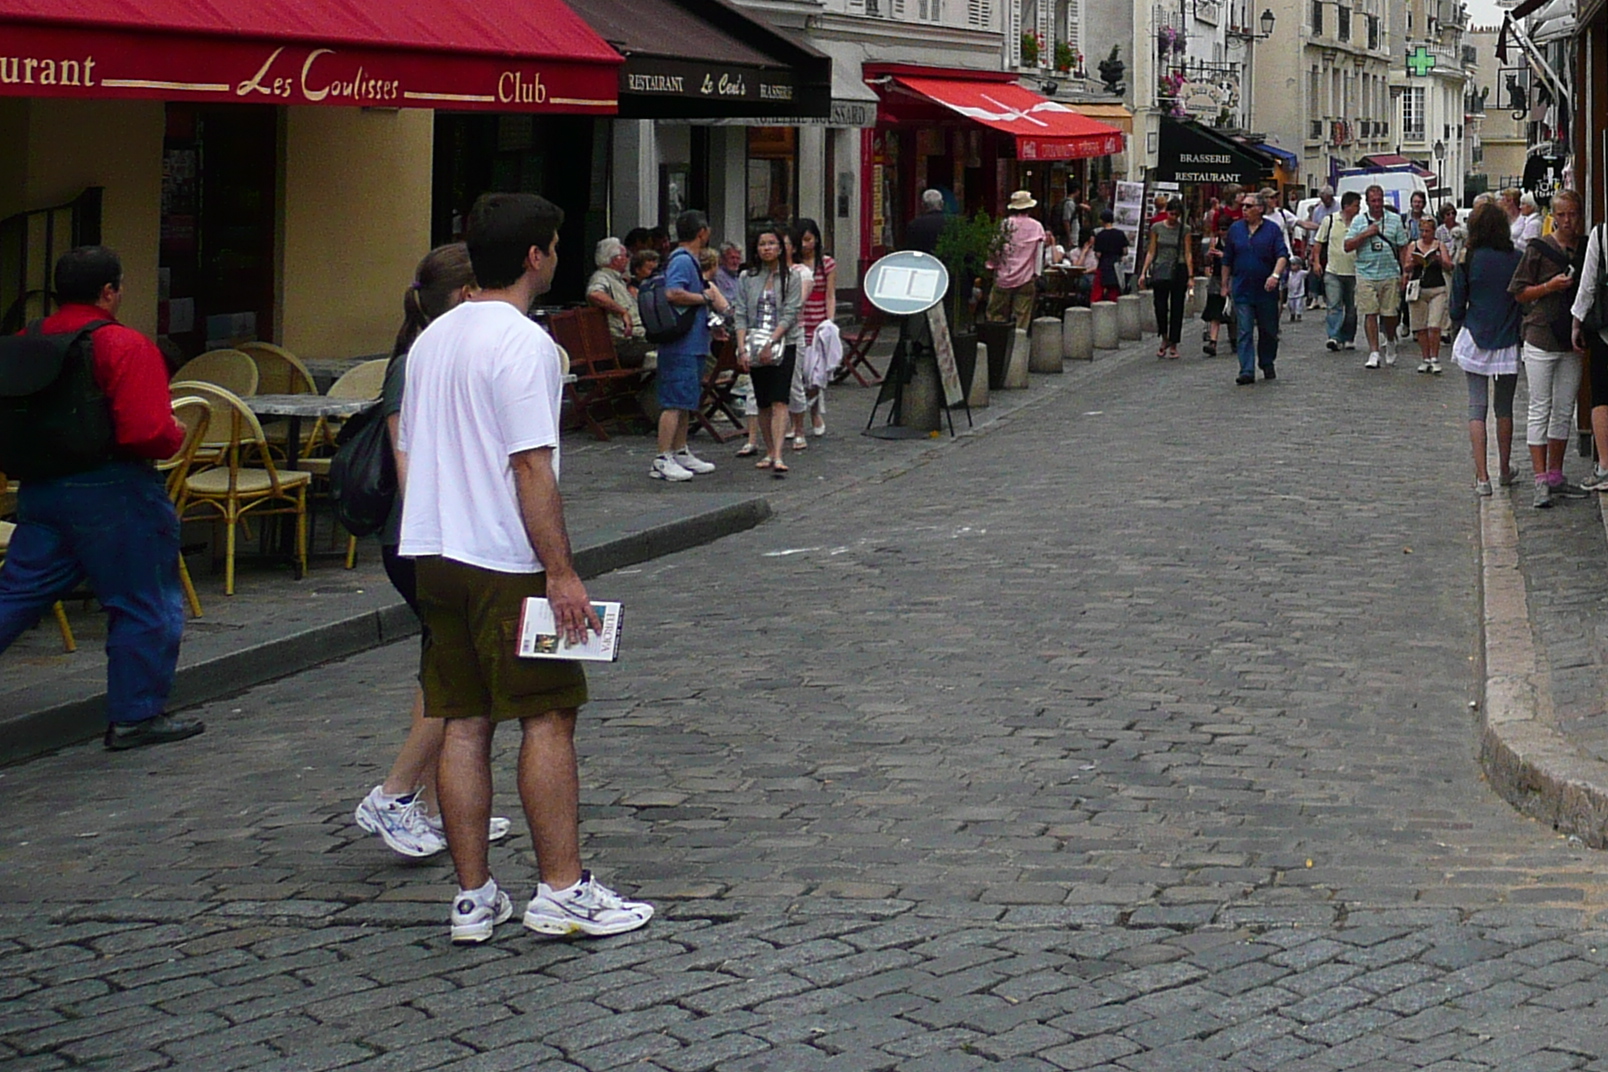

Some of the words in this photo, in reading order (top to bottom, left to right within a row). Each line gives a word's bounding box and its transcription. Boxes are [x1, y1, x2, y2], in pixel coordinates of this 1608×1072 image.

[236, 46, 293, 98] Les
[301, 47, 399, 101] Coulisses
[498, 71, 547, 104] Club
[628, 74, 684, 93] RESTAURANT
[1180, 153, 1231, 164] BRASSERIE
[1175, 172, 1241, 183] RESTAURANT
